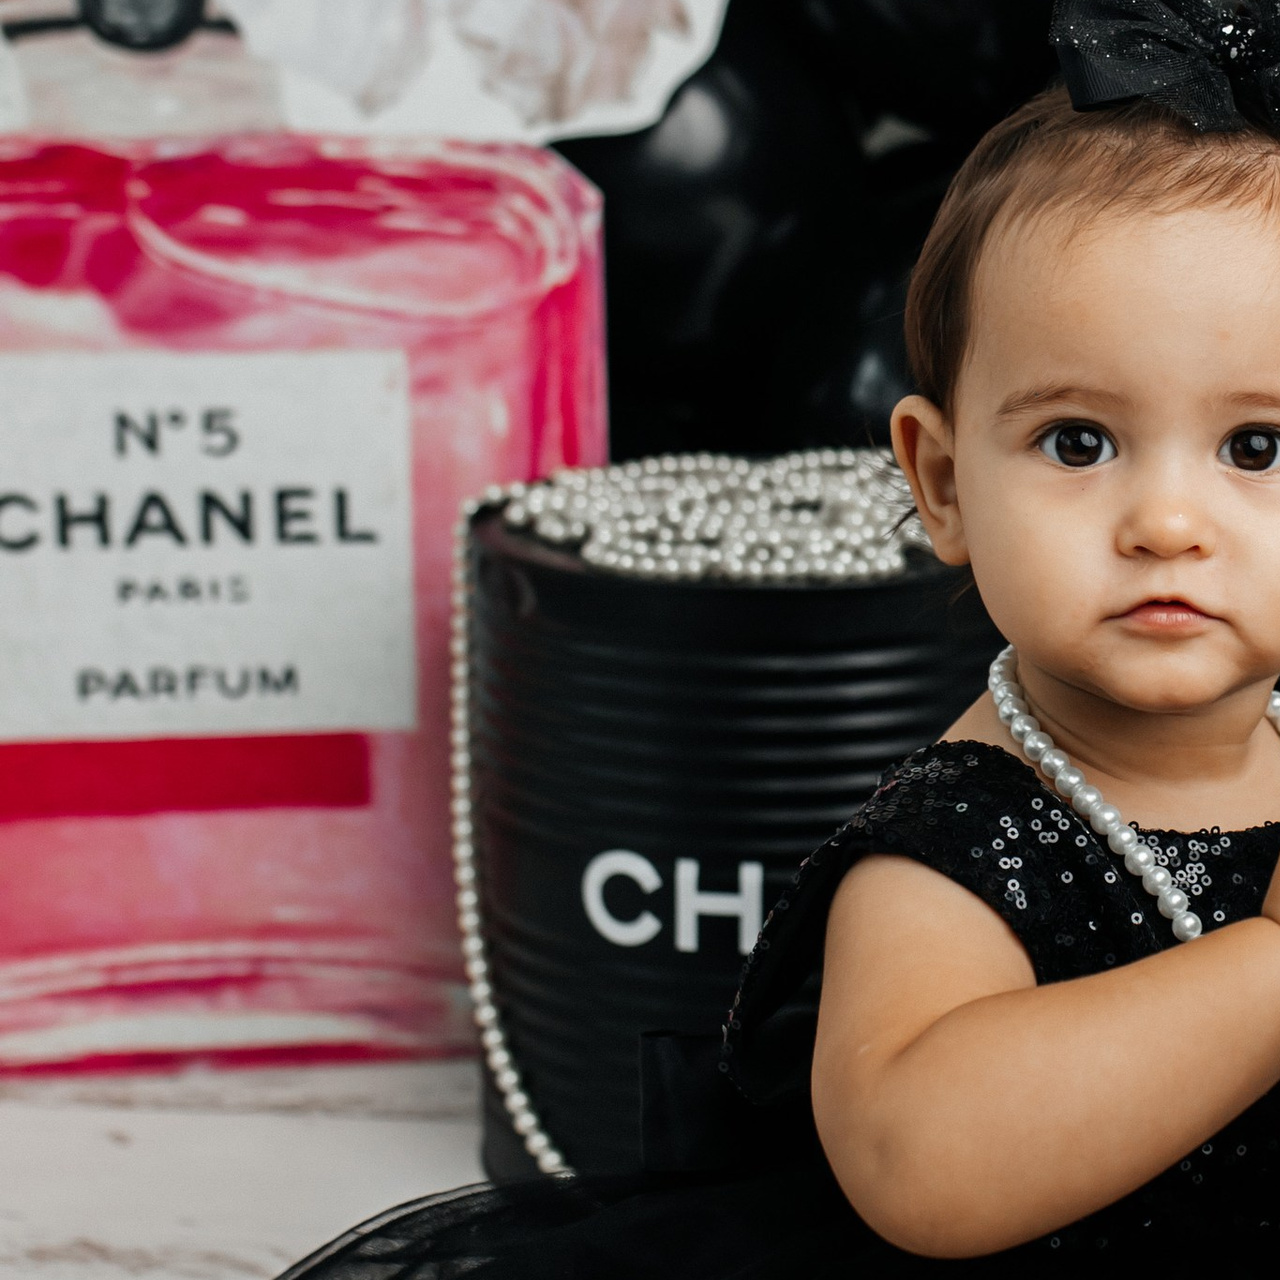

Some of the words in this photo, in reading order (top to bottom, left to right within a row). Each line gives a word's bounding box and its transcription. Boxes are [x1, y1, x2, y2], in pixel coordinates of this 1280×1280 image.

[0, 487, 377, 552] CHANEL
[116, 575, 250, 605] PARIS
[76, 664, 300, 704] PARFUM
